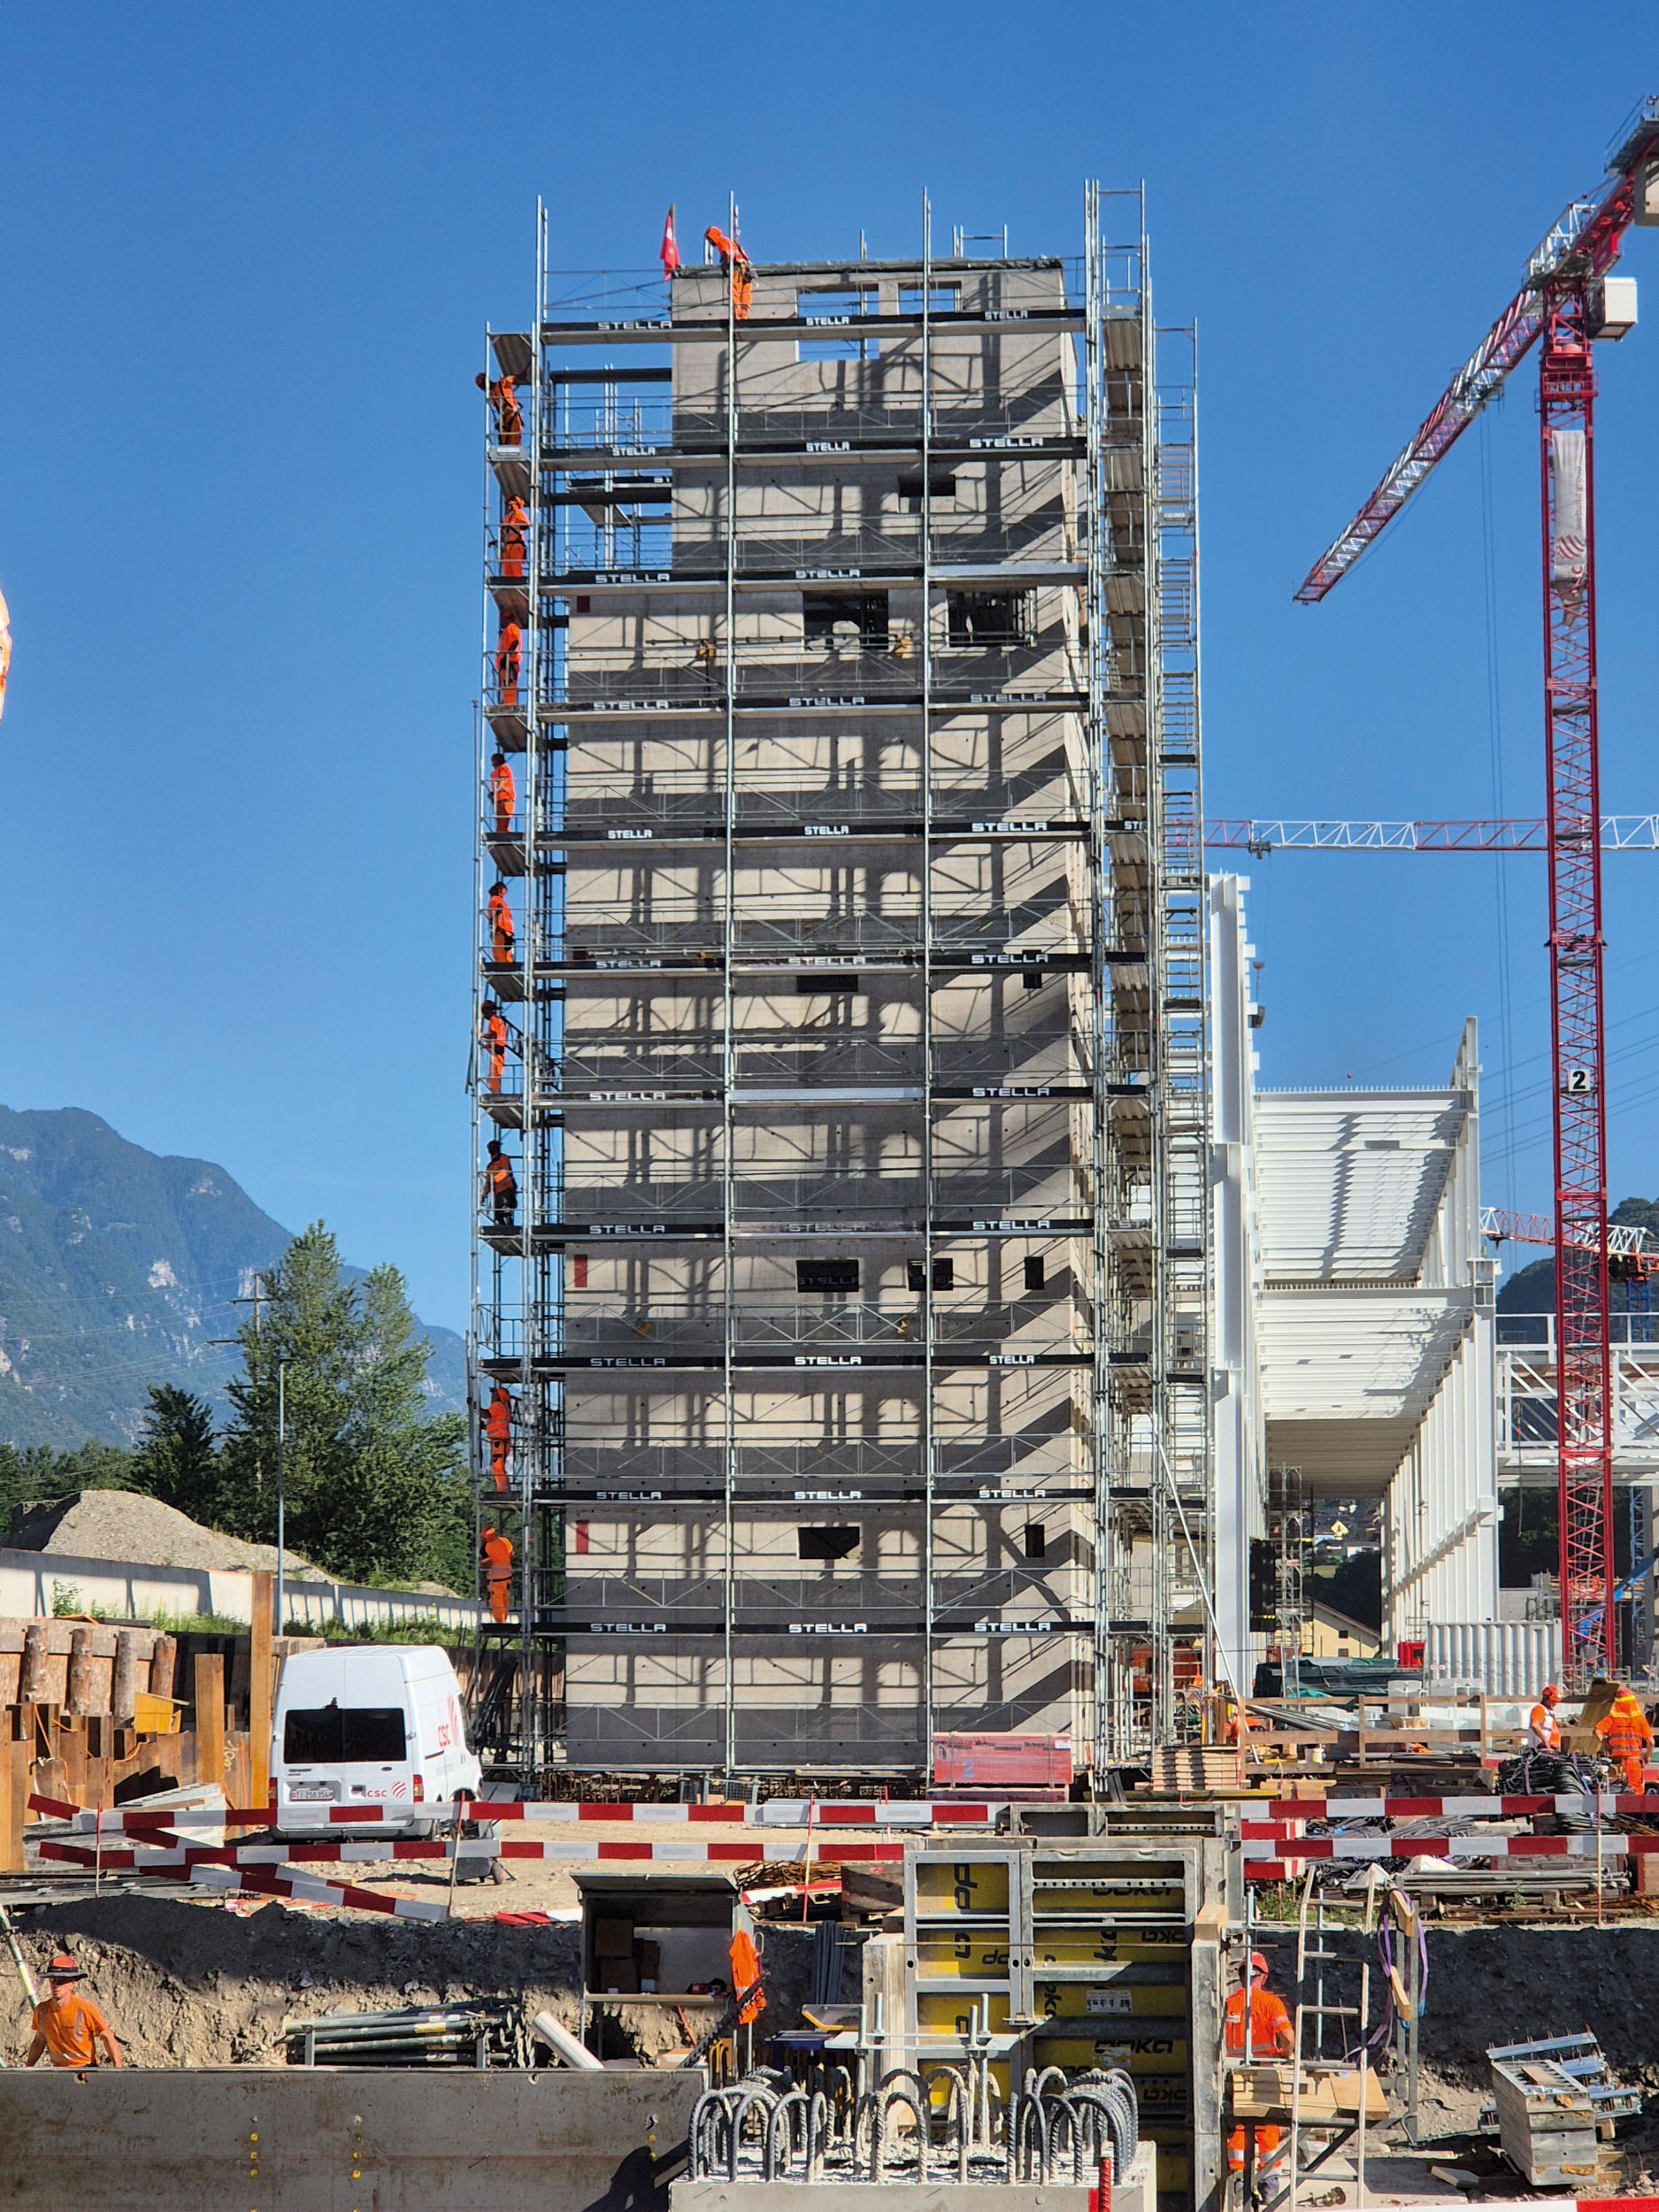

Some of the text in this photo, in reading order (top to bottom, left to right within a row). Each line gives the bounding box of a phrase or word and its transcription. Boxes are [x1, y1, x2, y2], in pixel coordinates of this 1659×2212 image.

[985, 311, 1028, 319] STELLA
[598, 320, 672, 330] STELLA
[806, 316, 849, 326] STELLA
[806, 442, 849, 451] STELLA
[969, 437, 1043, 448] STELLA
[612, 447, 656, 456] STELLA
[595, 572, 670, 583] STELLA
[795, 569, 860, 579] STELLA
[789, 696, 864, 707] STELLA
[970, 693, 1046, 703] STELLA
[593, 701, 669, 710] STELLA
[804, 826, 849, 835] STELLA
[972, 822, 1048, 832] STELLA
[608, 829, 652, 839] STELLA
[788, 956, 865, 965] STELLA
[972, 954, 1048, 964] STELLA
[595, 960, 661, 969] STELLA
[1572, 1071, 1586, 1089] 2
[972, 1087, 1049, 1096] STELLA
[589, 1092, 665, 1101] STELLA
[589, 1225, 665, 1234] STELLA
[973, 1220, 1050, 1230] STELLA
[795, 1356, 862, 1365] STELLA
[989, 1355, 1034, 1364] STELLA
[795, 1491, 862, 1500] STELLA
[979, 1489, 1046, 1498] STELLA
[590, 1623, 666, 1632] STELLA
[788, 1623, 867, 1632] STELLA
[974, 1622, 1051, 1632] STELLA
[438, 1724, 450, 1747] CSC
